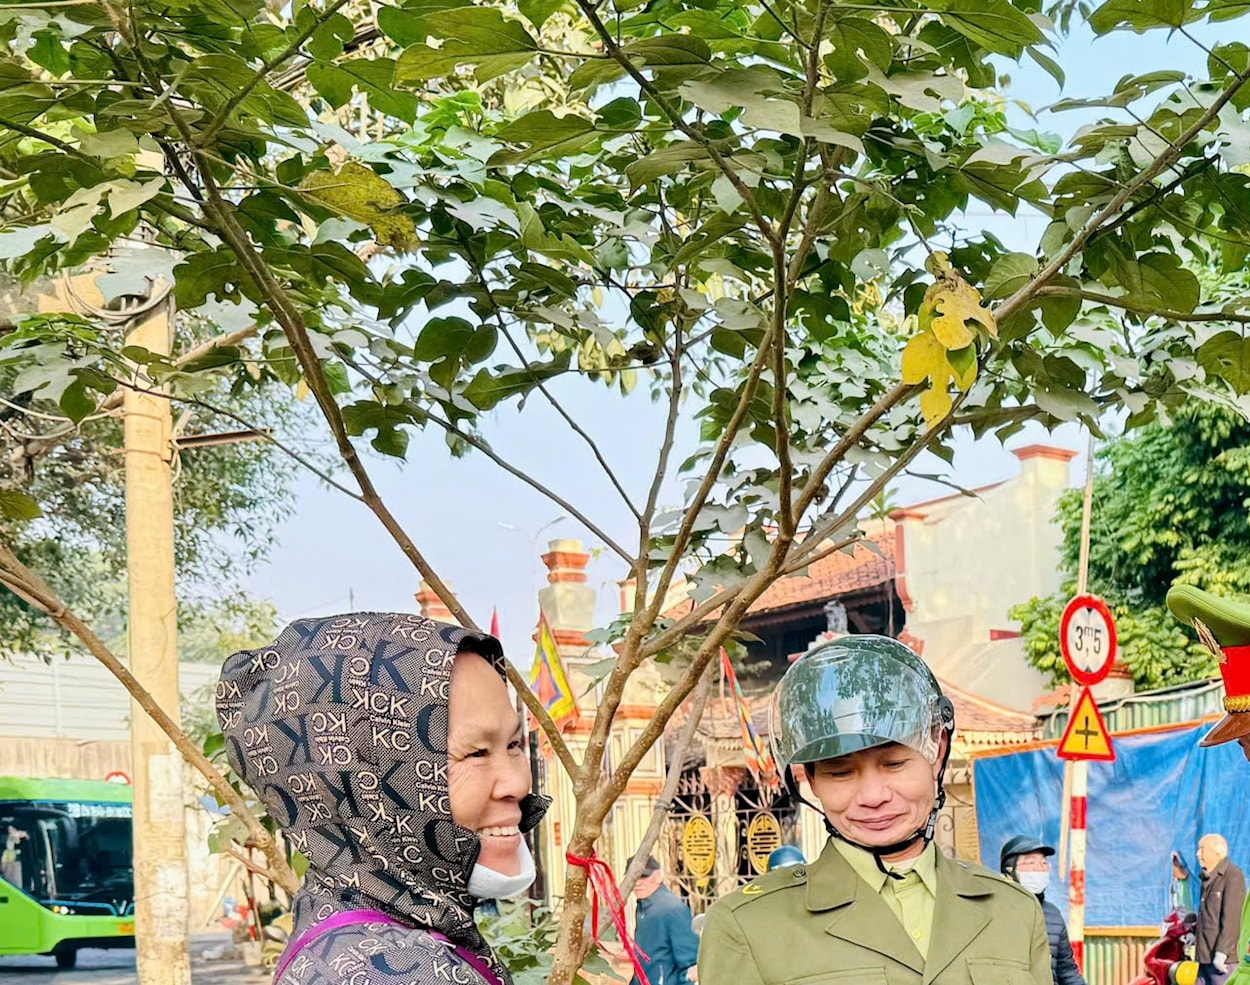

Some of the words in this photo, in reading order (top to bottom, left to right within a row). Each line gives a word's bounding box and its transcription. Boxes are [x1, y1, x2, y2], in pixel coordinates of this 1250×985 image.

[321, 635, 358, 650] CK
[391, 625, 432, 642] KC
[250, 650, 281, 674] CK
[425, 649, 456, 668] CK
[273, 690, 301, 715] CK
[370, 692, 409, 718] CK
[312, 712, 347, 733] KC
[372, 726, 411, 751] KC
[319, 745, 352, 766] CK
[415, 760, 448, 781] CK
[288, 773, 317, 793] KC
[432, 867, 466, 884] CK
[432, 960, 469, 984] KC
